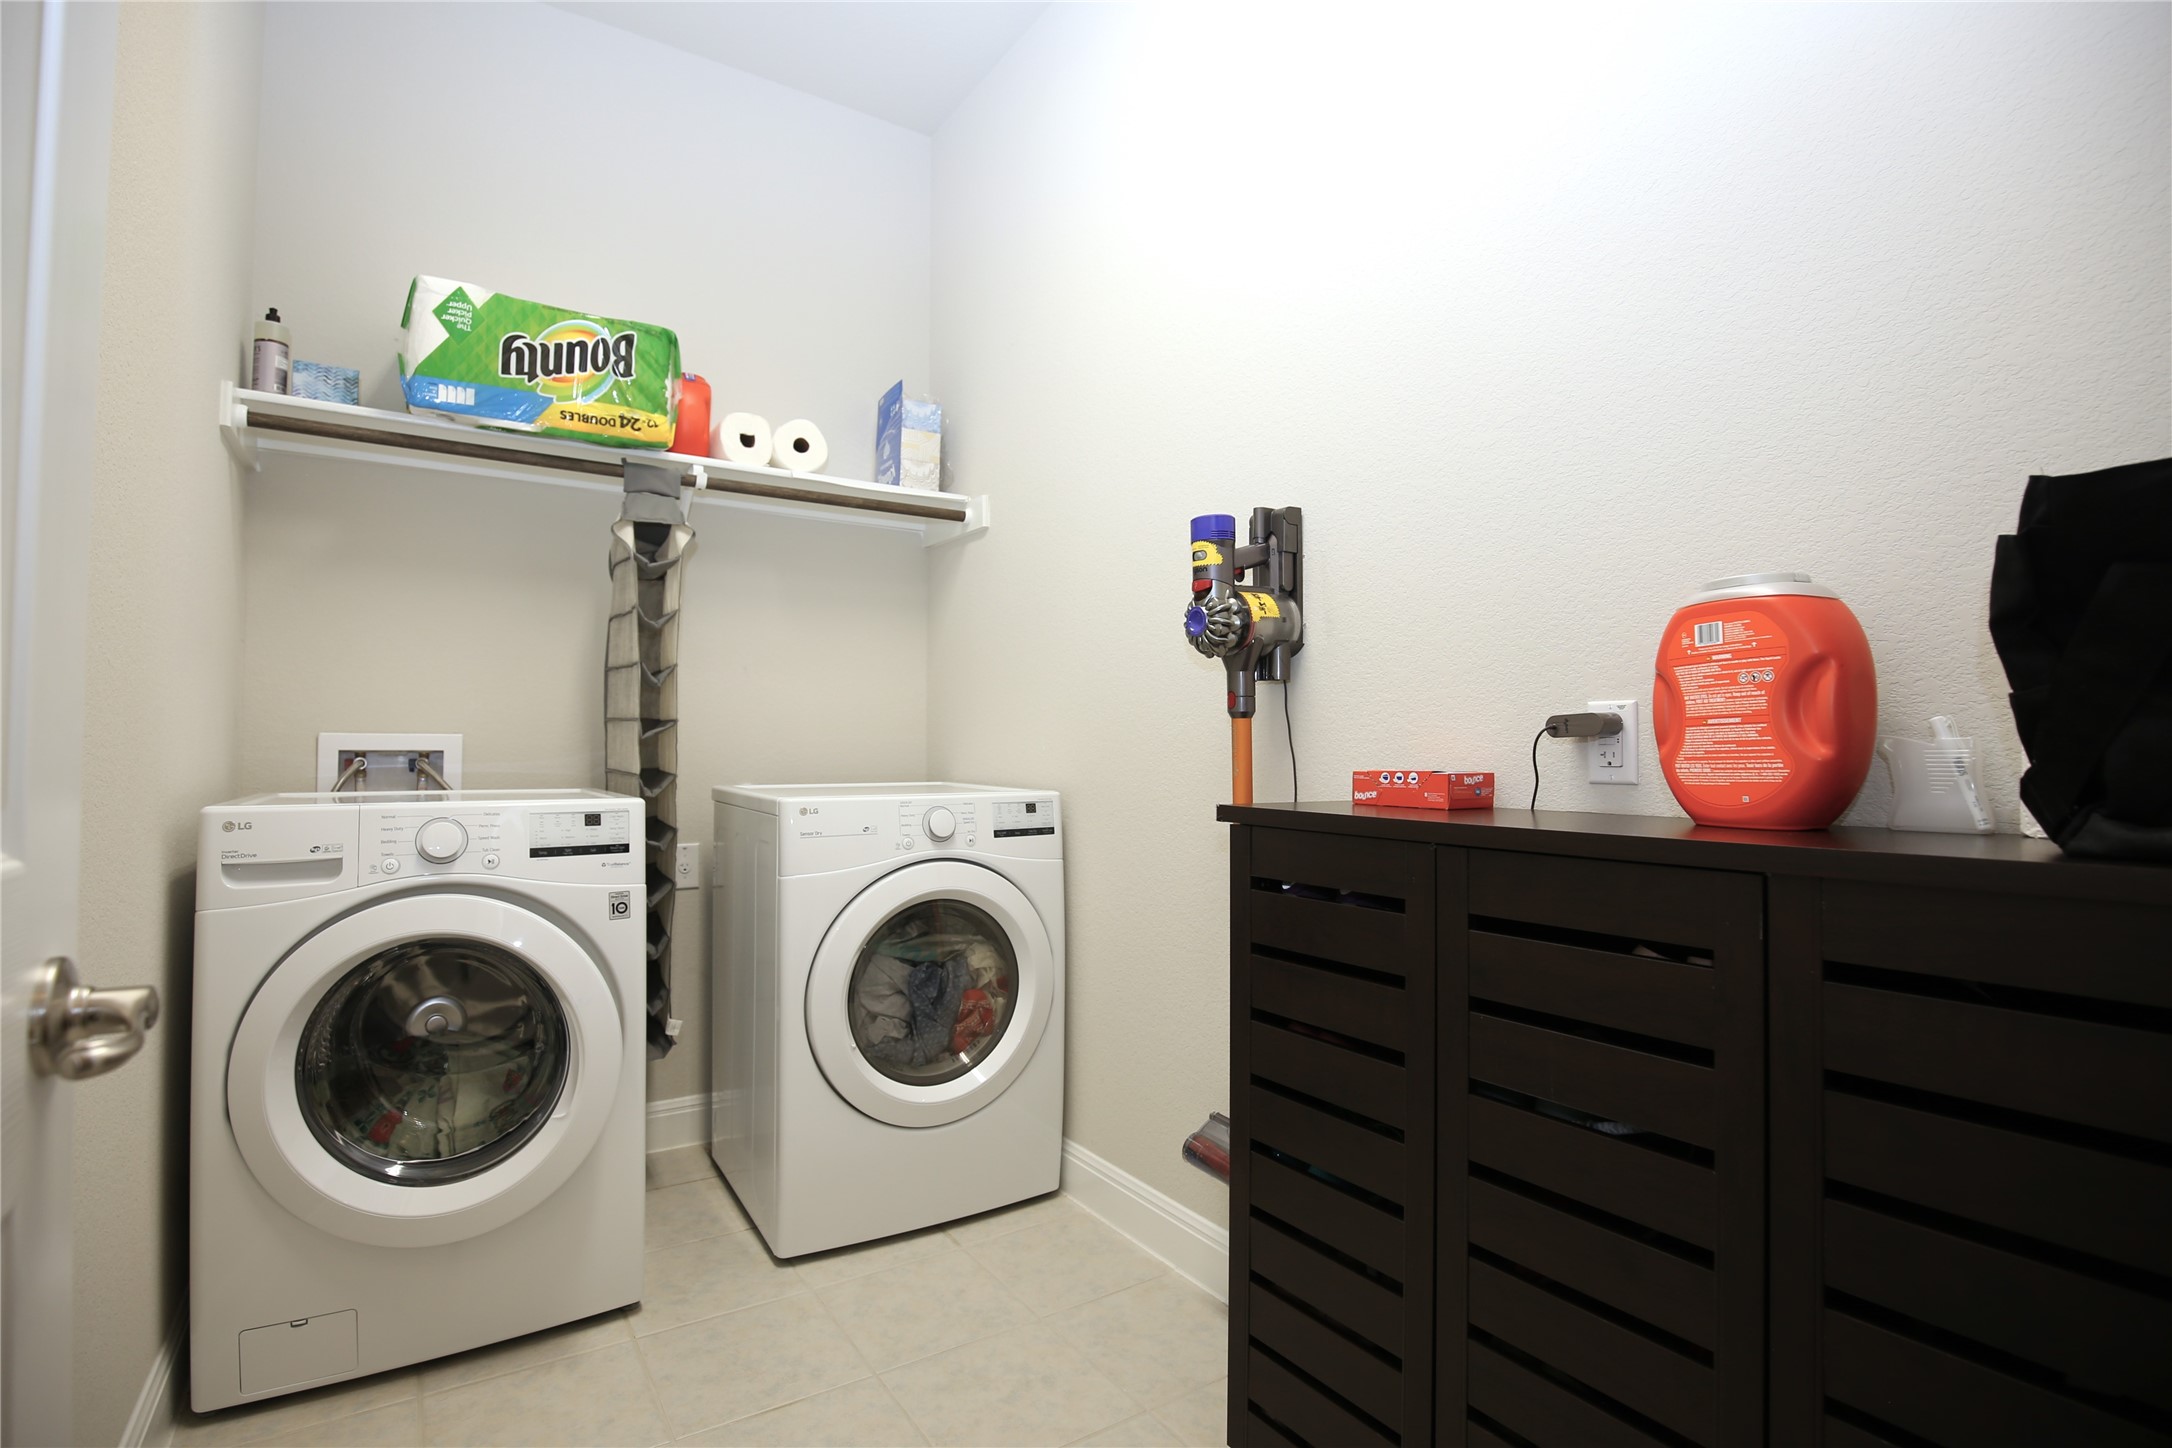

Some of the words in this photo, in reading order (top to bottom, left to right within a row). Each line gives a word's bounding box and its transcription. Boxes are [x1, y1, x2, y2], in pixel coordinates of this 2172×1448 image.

[447, 301, 472, 311] Upper
[447, 308, 472, 318] Picker
[441, 314, 472, 324] Quicker
[456, 324, 472, 332] The
[500, 333, 636, 384] Bounty
[560, 410, 616, 428] DOUBLES
[1464, 774, 1484, 785] bounce
[1354, 790, 1377, 800] bounce
